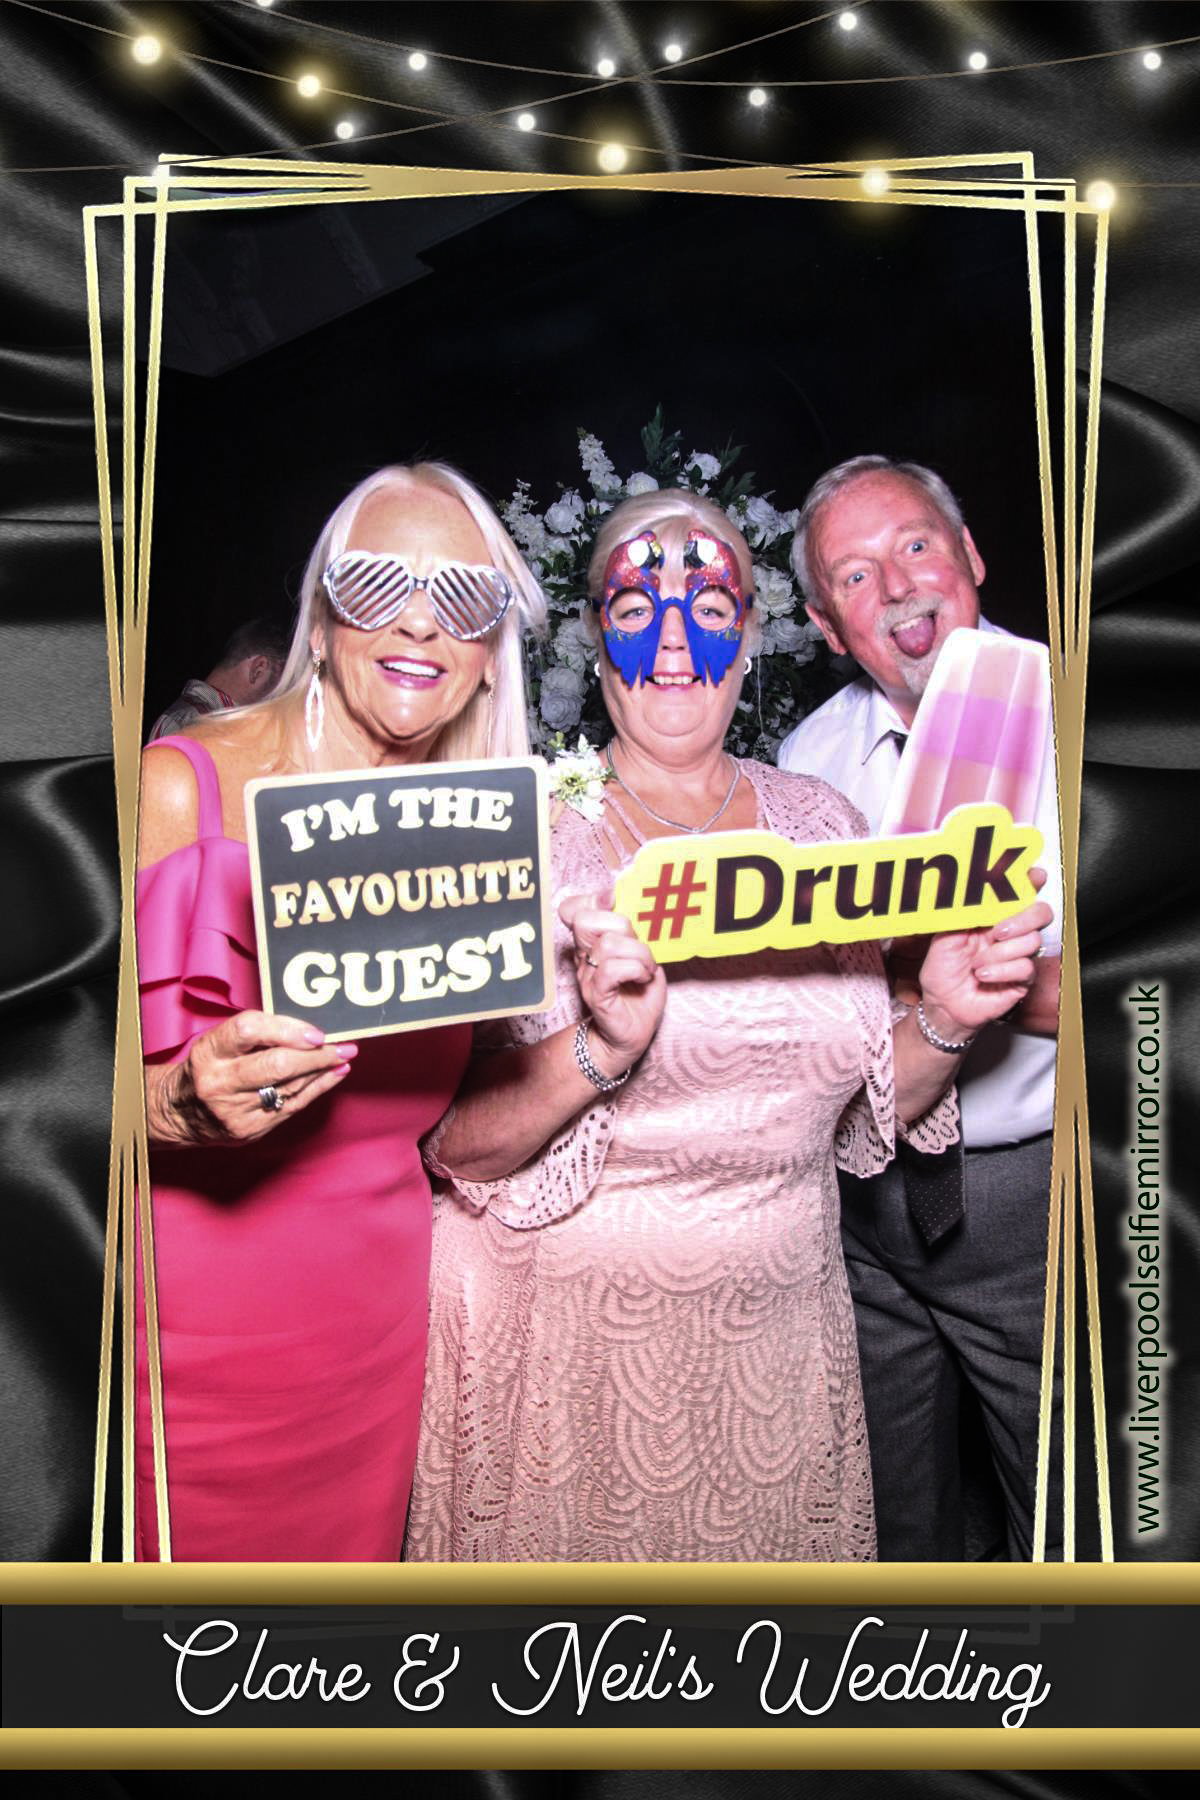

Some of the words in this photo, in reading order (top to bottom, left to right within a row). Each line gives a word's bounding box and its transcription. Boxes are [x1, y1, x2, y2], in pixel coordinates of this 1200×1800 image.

[280, 793, 379, 852] I'M
[388, 788, 514, 832] THE
[270, 857, 535, 928] FAVOURITE
[637, 825, 1028, 942] #Drunk
[283, 921, 536, 1007] GUEST
